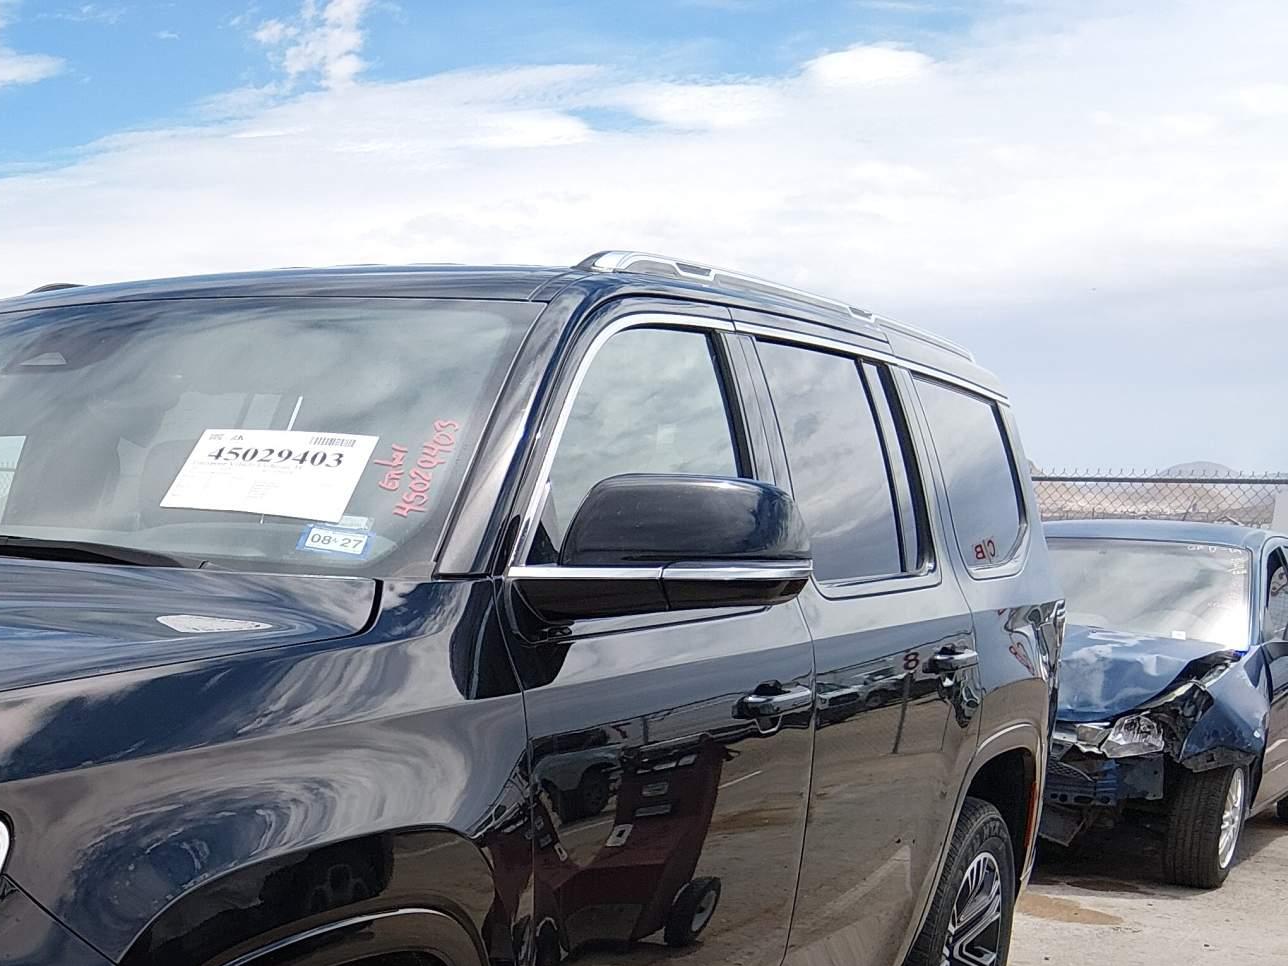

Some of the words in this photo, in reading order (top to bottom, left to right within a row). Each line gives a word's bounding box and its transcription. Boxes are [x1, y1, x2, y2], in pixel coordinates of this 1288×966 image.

[207, 446, 345, 468] 45029403
[311, 533, 332, 545] 08
[339, 537, 363, 549] 27
